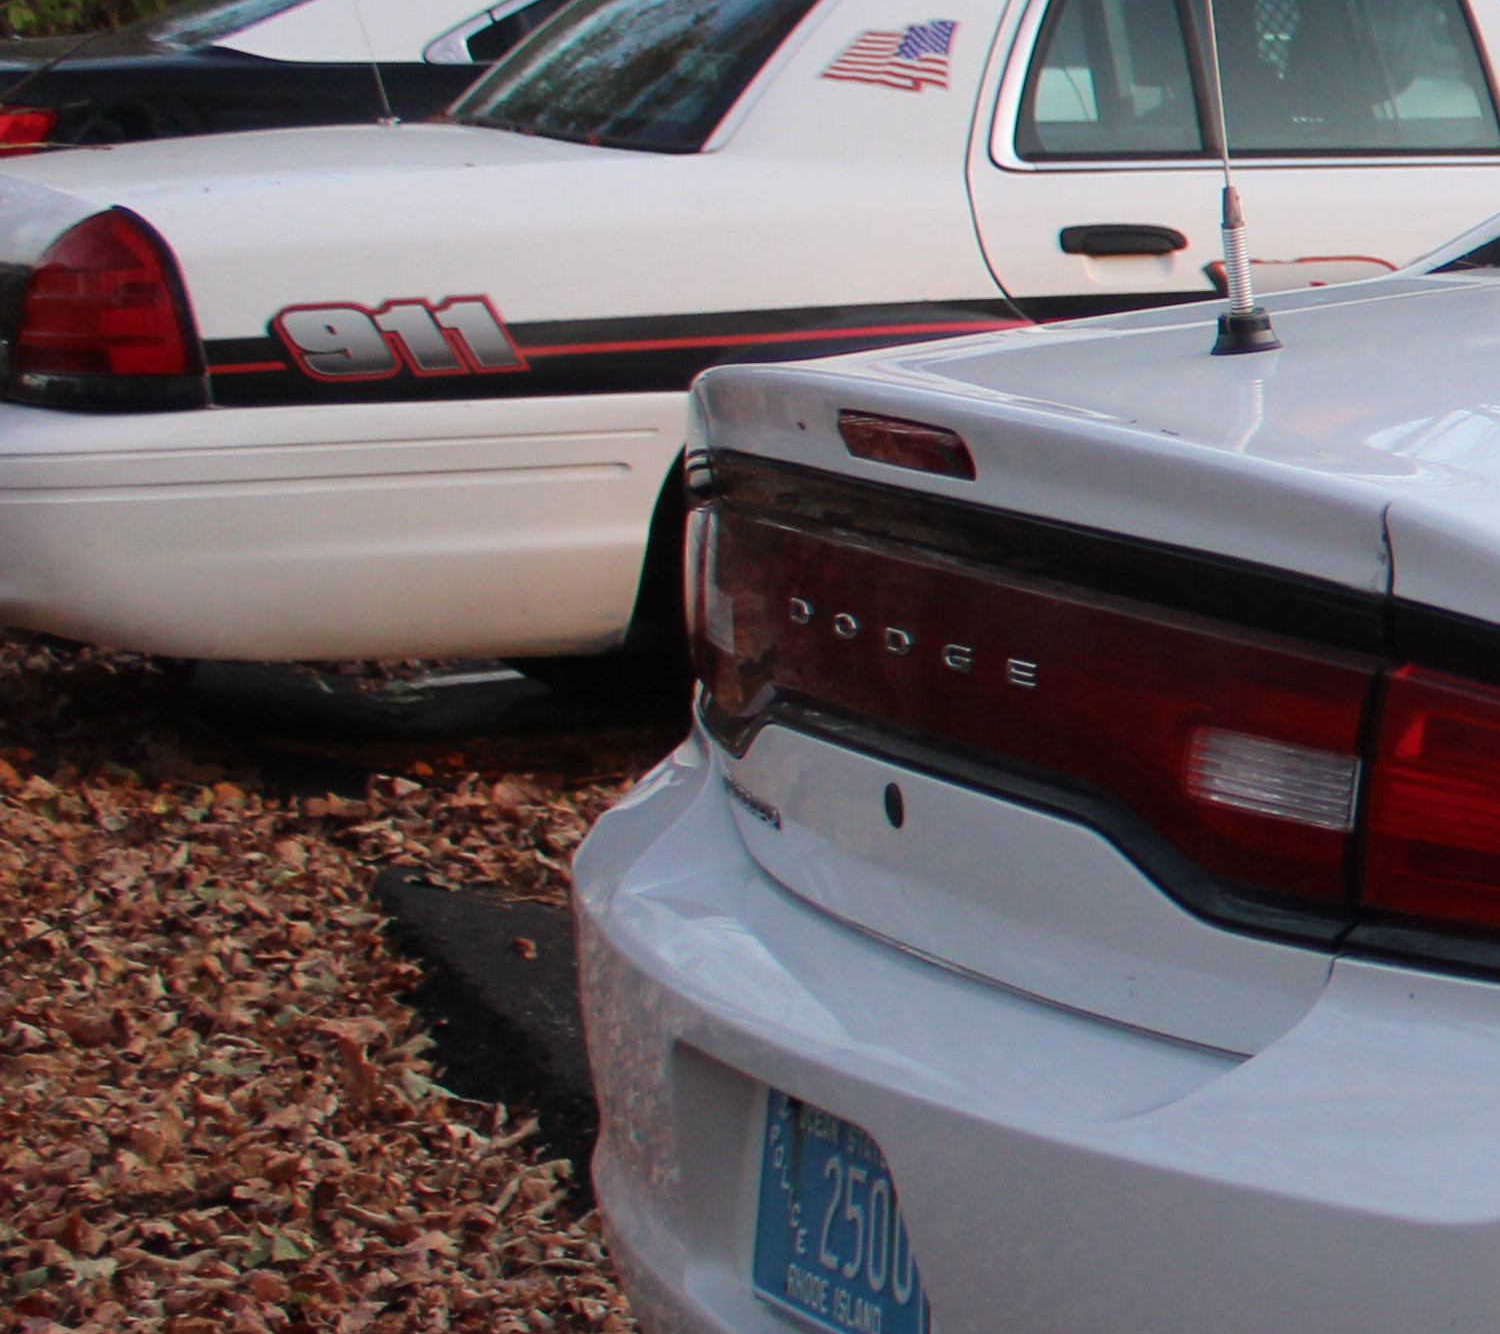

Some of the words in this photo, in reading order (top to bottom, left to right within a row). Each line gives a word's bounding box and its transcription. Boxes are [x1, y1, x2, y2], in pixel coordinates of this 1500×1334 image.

[272, 294, 530, 381] 911
[790, 597, 1037, 687] DODGE
[847, 1121, 888, 1169] STAT
[769, 1125, 807, 1255] POLICE
[820, 1154, 913, 1305] 2500
[785, 1264, 829, 1314] RHODE
